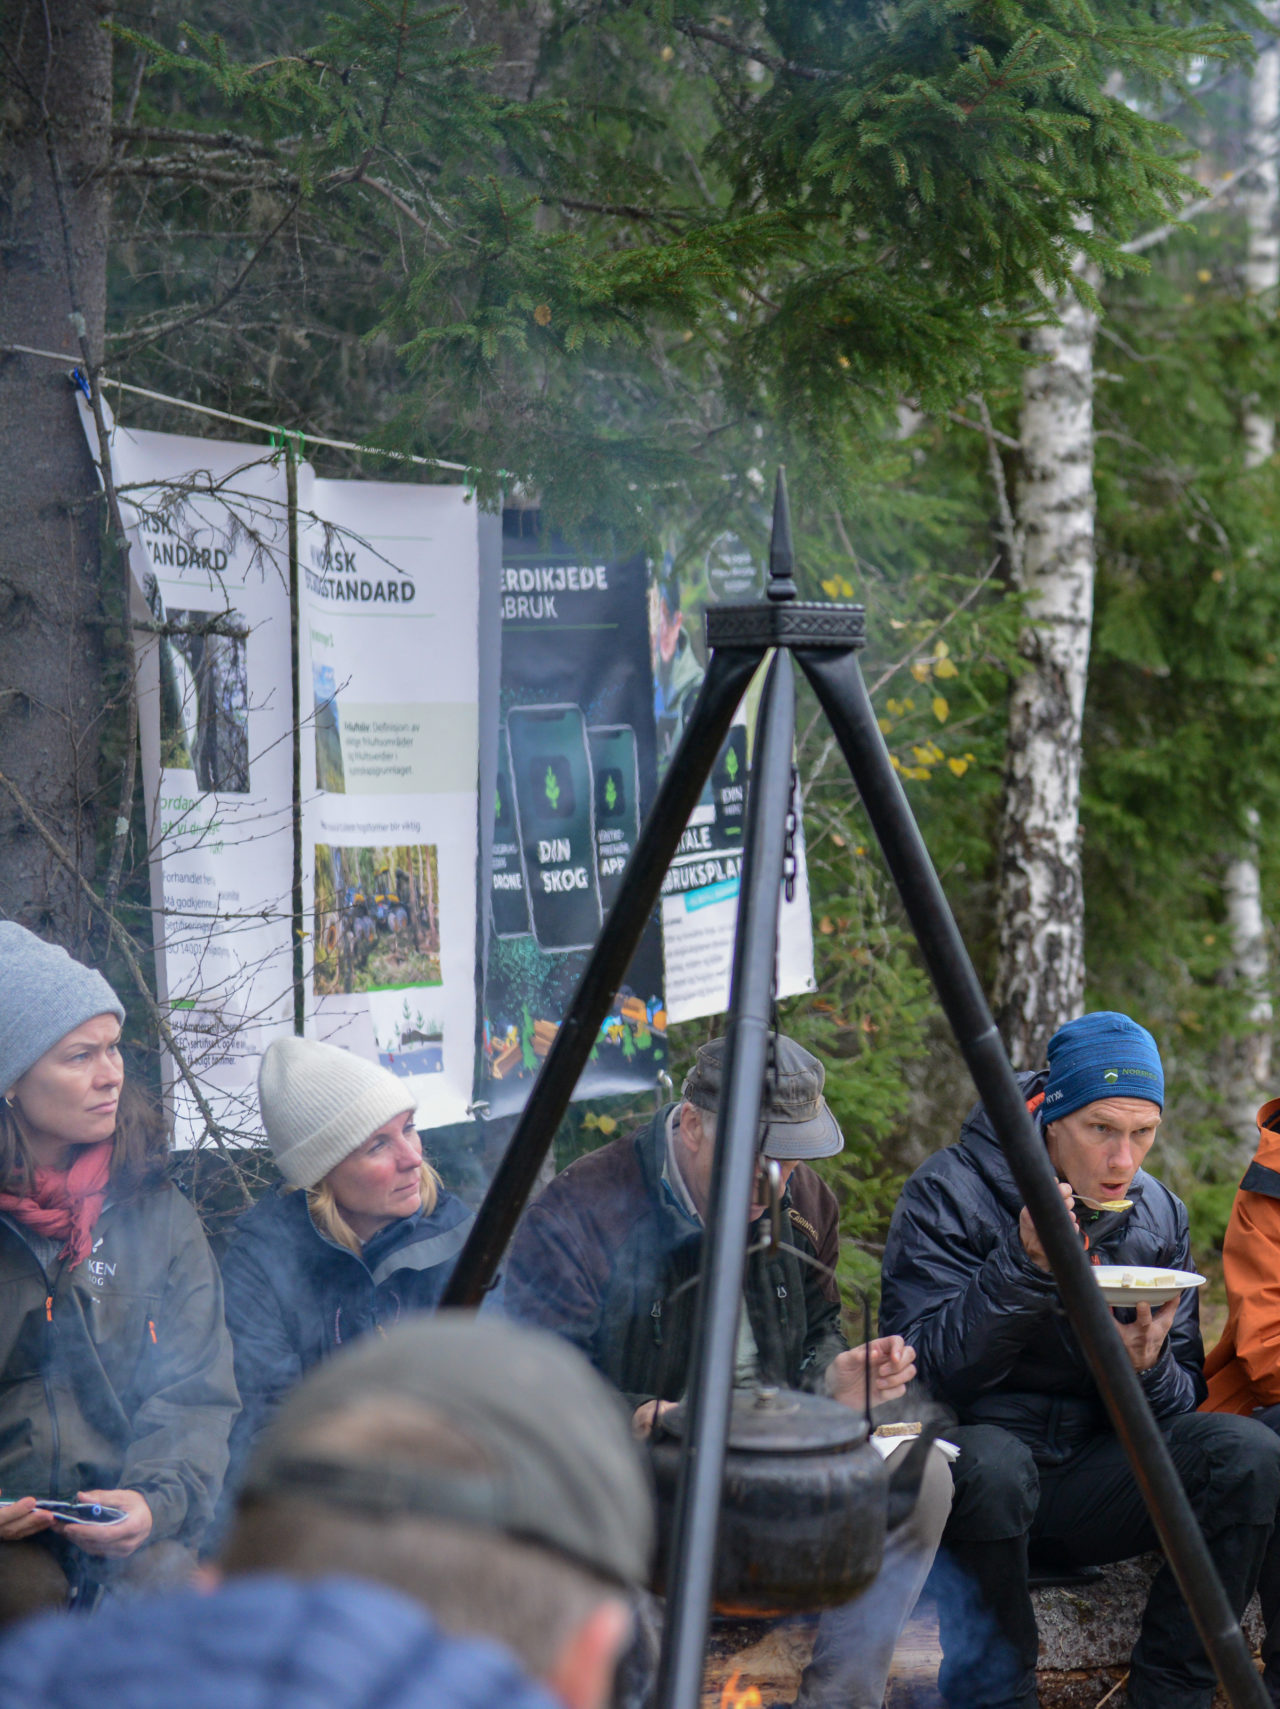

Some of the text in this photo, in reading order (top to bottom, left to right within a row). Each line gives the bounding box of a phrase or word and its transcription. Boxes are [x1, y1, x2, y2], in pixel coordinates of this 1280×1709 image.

[500, 596, 559, 619] BRUK
[538, 837, 571, 865] DIN
[542, 867, 590, 894] SKOG
